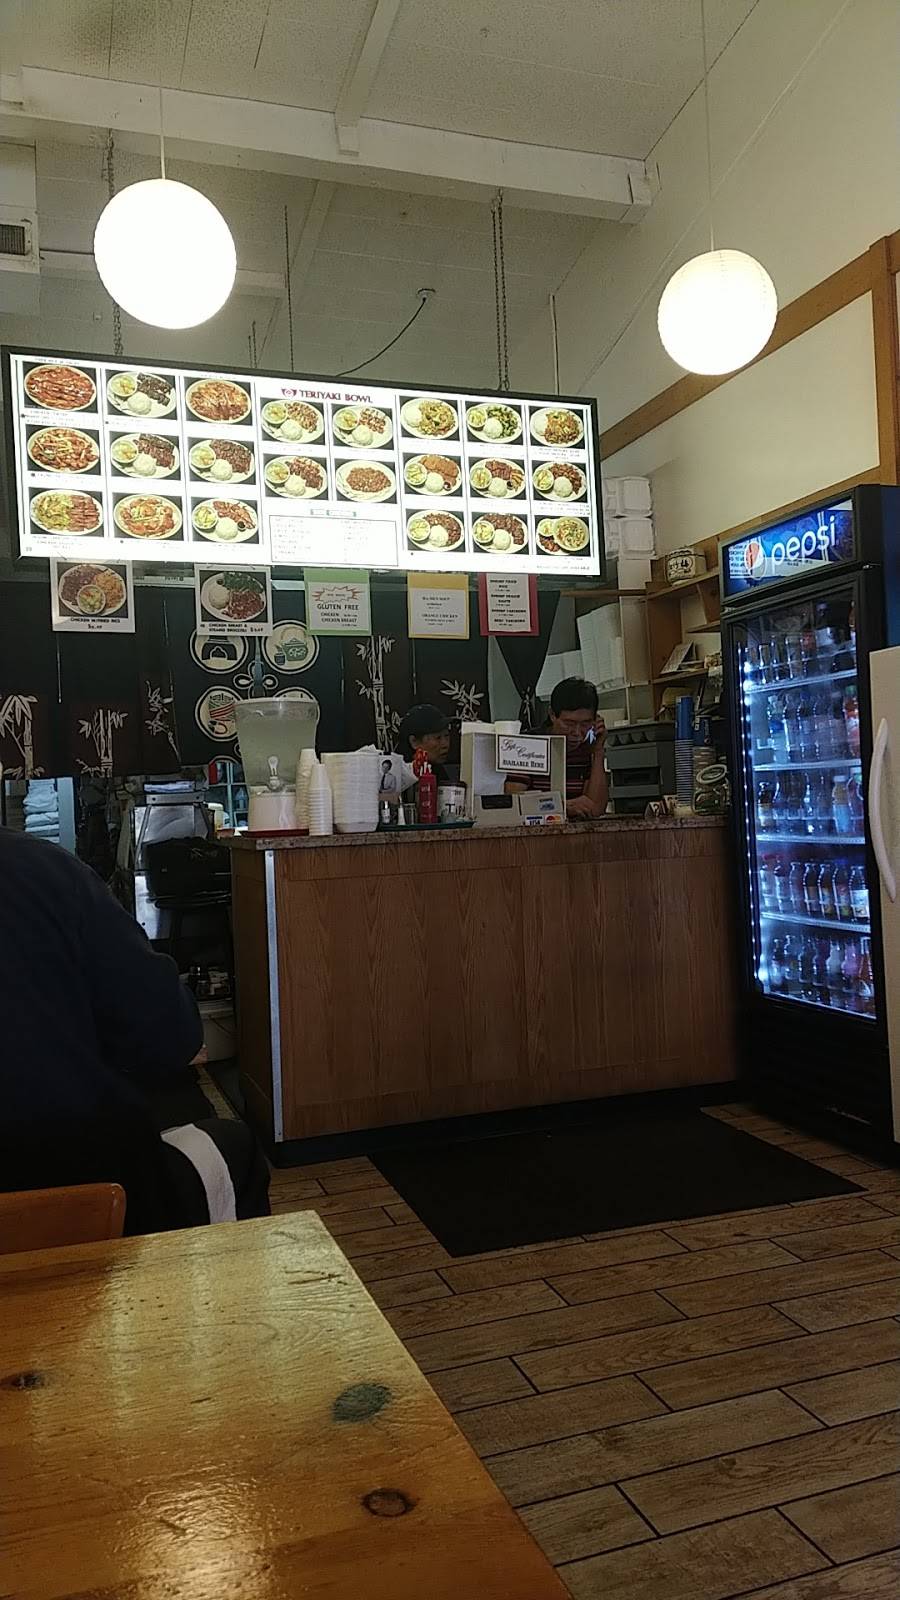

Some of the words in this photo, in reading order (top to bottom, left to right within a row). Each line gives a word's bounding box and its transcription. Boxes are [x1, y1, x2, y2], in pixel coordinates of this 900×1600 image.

[299, 389, 341, 401] TERIYAKI
[345, 394, 373, 404] BOWL
[771, 515, 836, 575] pepsi
[530, 760, 545, 769] HERE
